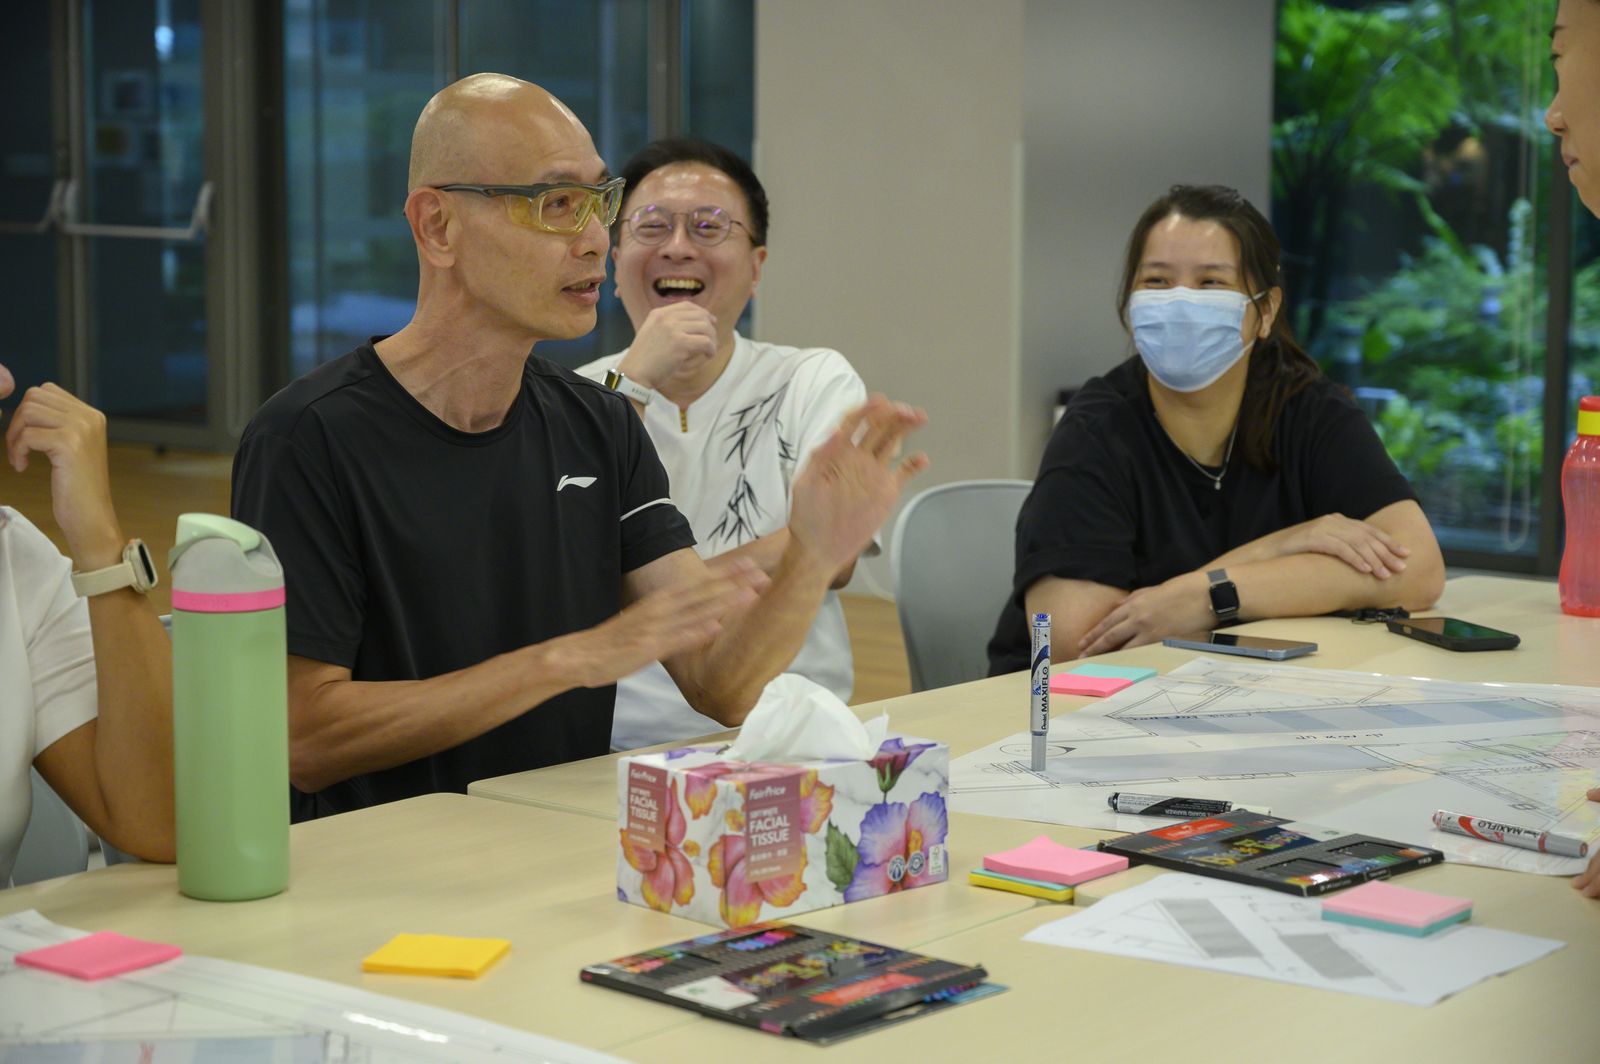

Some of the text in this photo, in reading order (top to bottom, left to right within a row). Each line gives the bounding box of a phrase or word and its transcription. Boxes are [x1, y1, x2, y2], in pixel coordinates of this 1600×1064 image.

[1040, 666, 1049, 713] MAXIFLO
[749, 786, 786, 800] FairPrice
[630, 794, 659, 811] FACIAL
[629, 806, 657, 823] TISSUE
[749, 814, 791, 833] FACIAL
[1478, 820, 1523, 834] MAXIFLO
[750, 828, 789, 846] TISSUE
